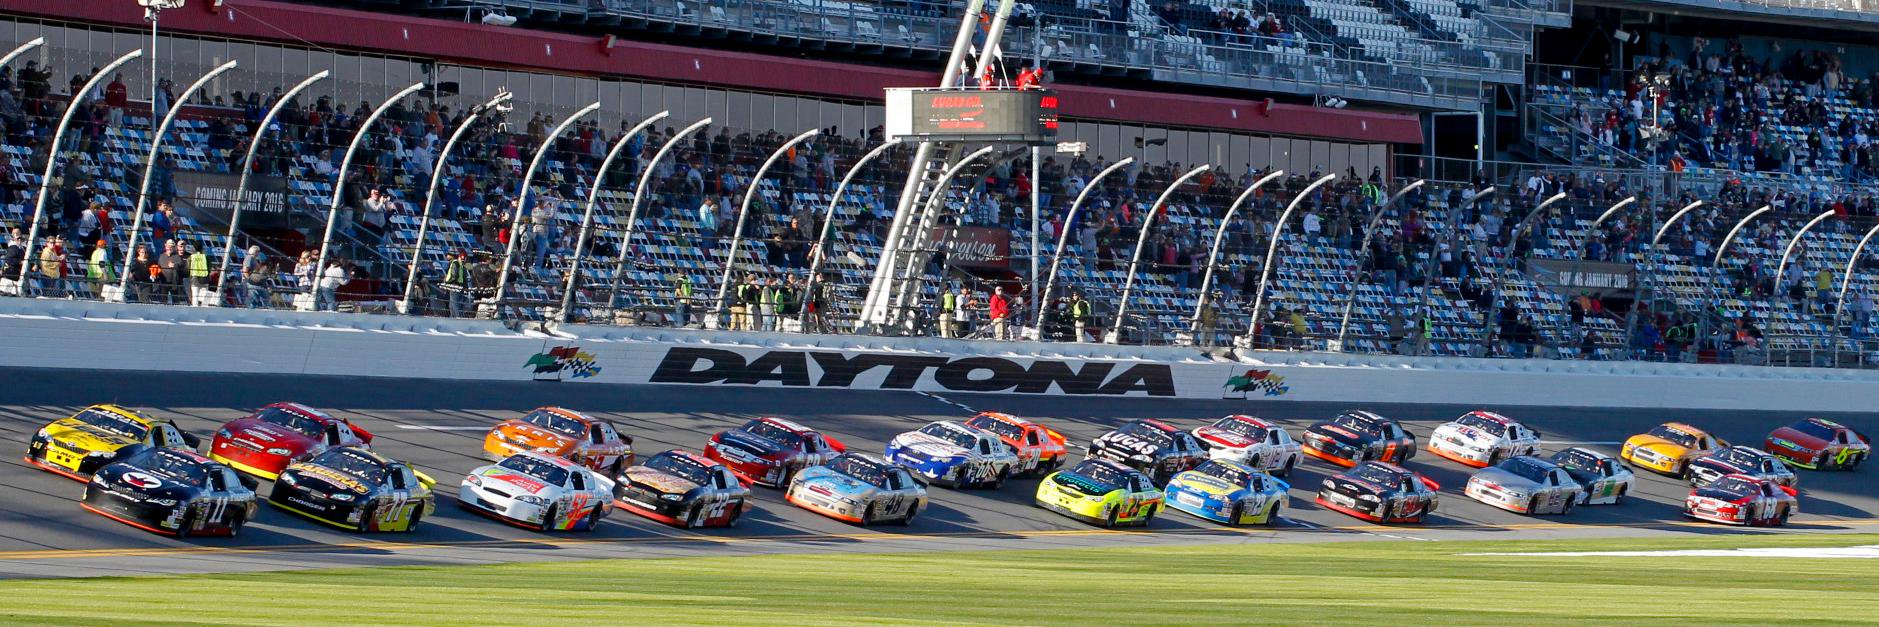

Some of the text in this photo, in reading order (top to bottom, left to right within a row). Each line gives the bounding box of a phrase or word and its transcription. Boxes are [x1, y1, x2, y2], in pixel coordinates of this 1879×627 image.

[194, 187, 284, 213] COMING JAUARY 2016
[1585, 272, 1612, 288] JANUARY
[649, 347, 1176, 397] DAYTONA
[1100, 430, 1159, 456] LUCAS
[1837, 447, 1849, 465] 6
[208, 497, 229, 523] 11
[288, 496, 326, 511] CHARGER
[710, 493, 730, 518] 22
